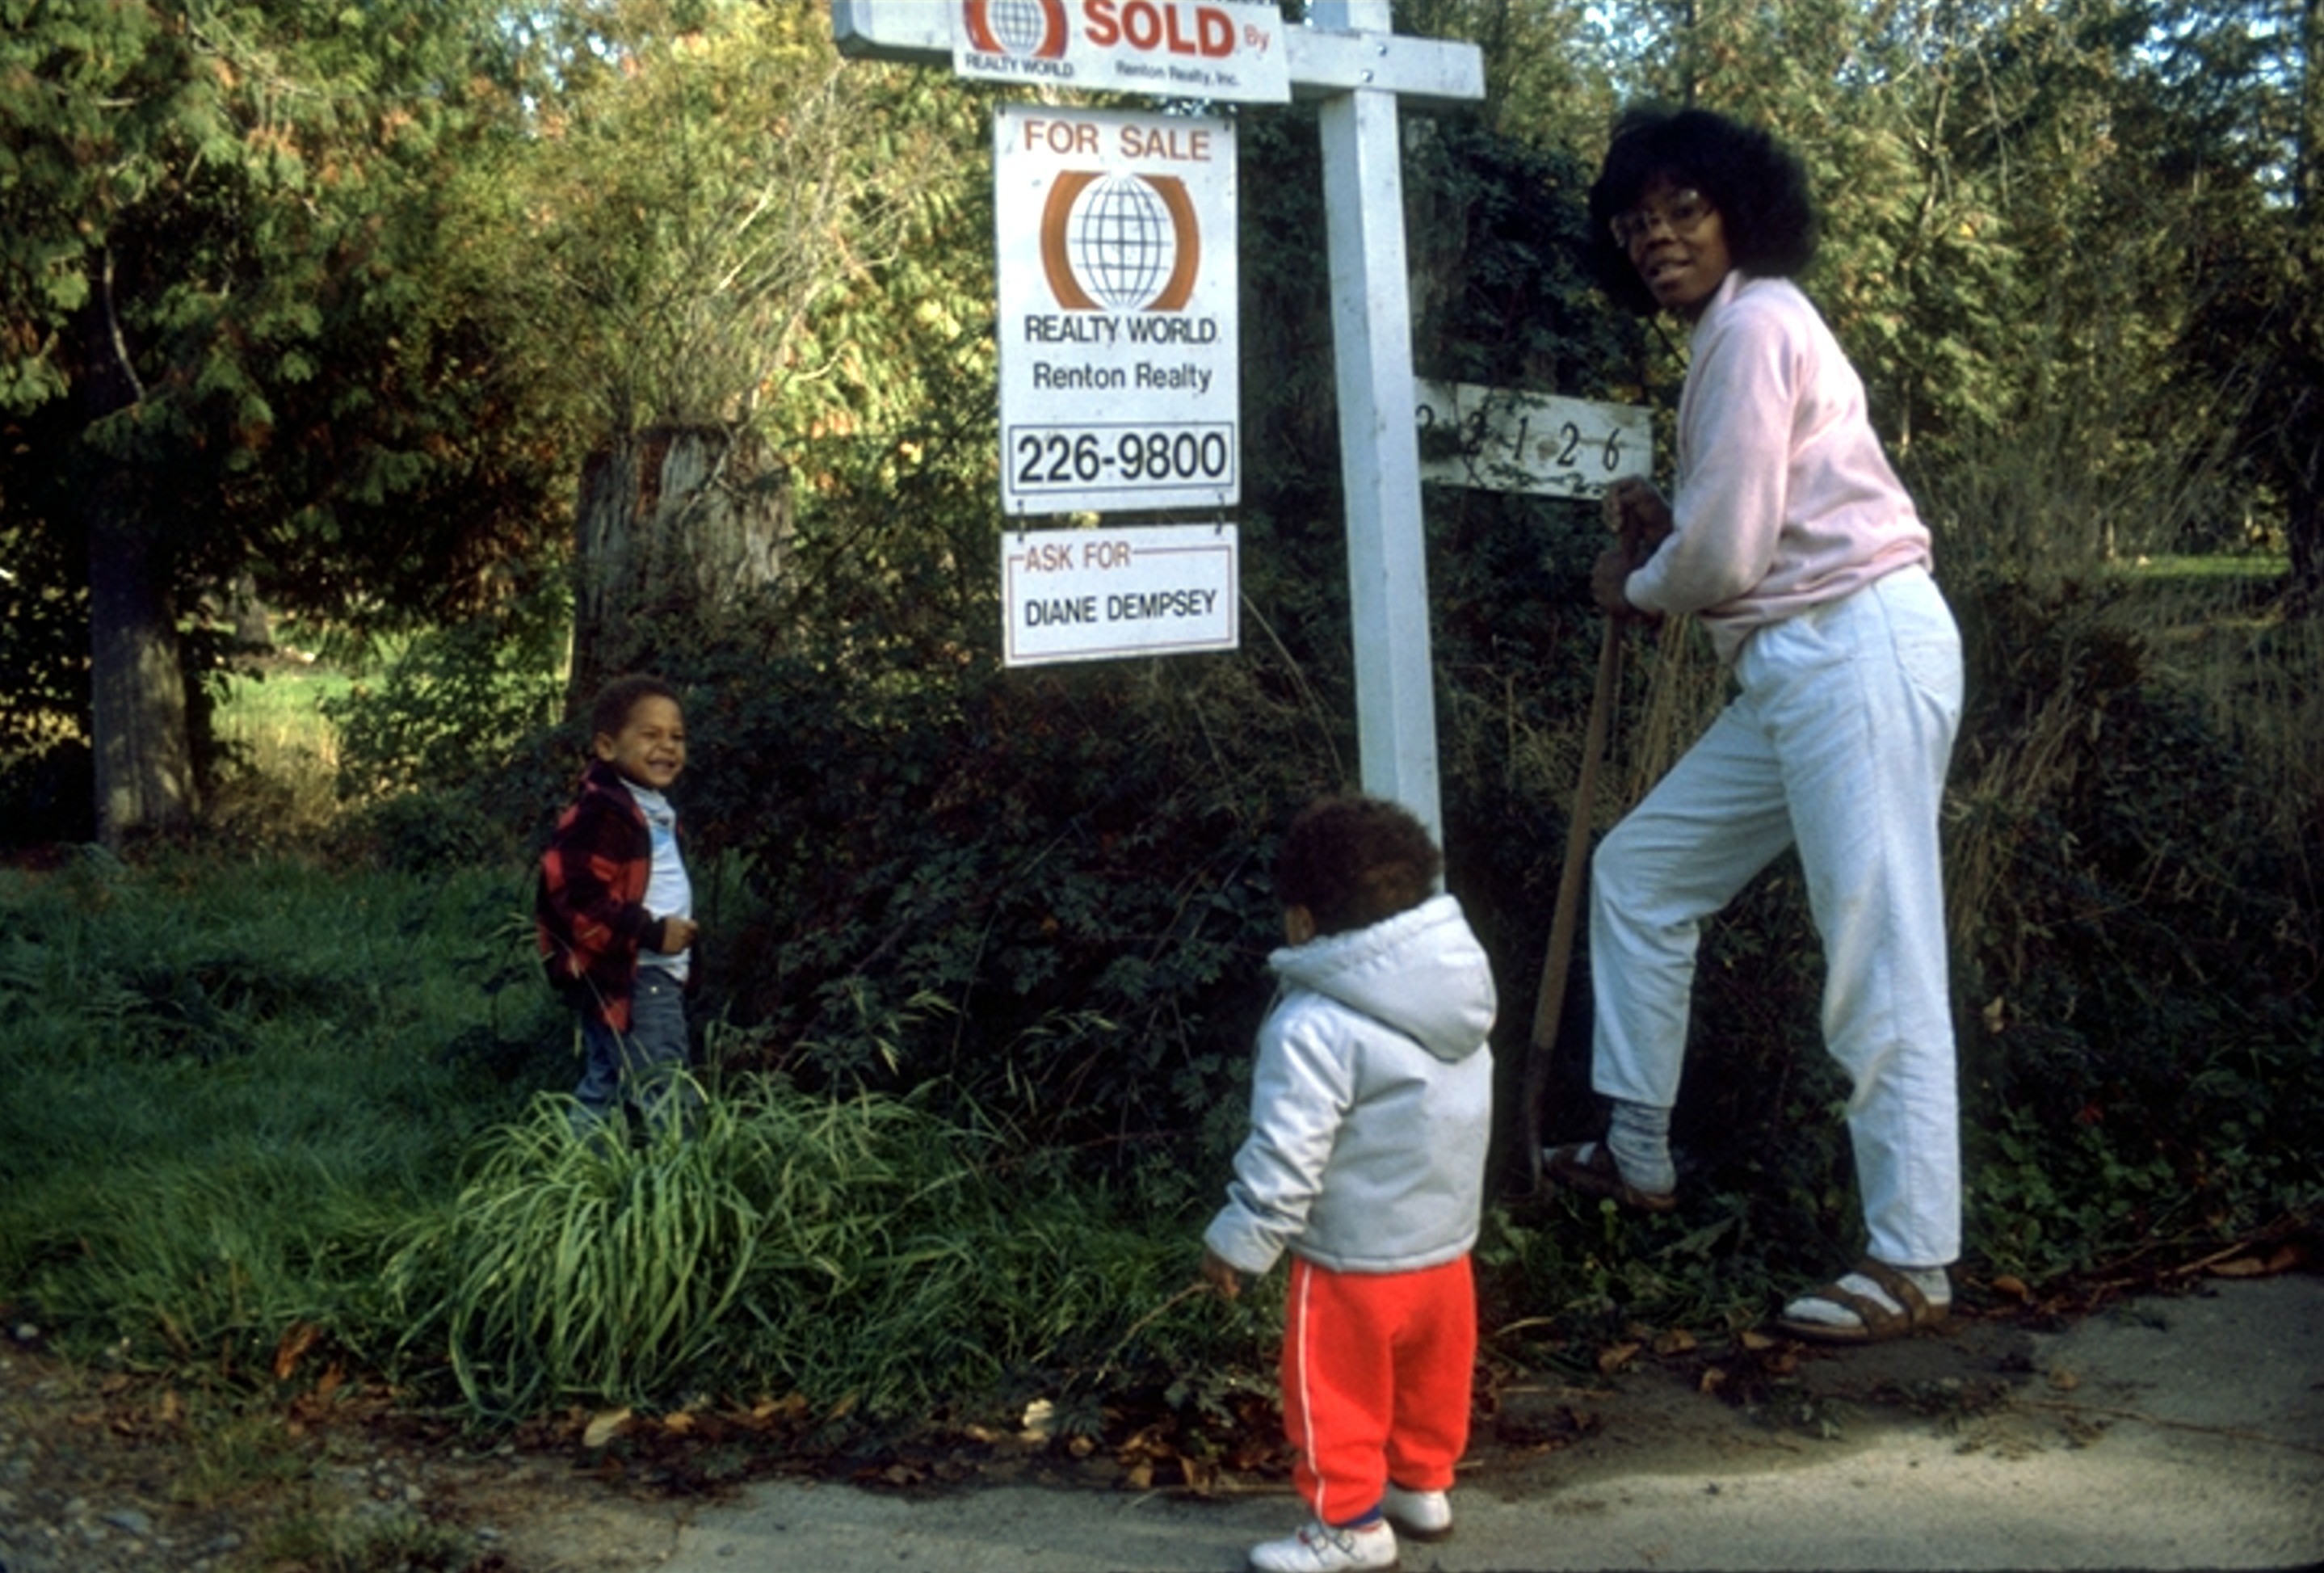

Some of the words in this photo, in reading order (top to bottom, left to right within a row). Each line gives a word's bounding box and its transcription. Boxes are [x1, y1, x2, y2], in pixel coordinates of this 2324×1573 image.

[1082, 0, 1236, 59] SOLD
[1244, 23, 1270, 53] By
[965, 53, 1018, 72] REALTY
[1022, 59, 1074, 78] WORLD
[1116, 60, 1166, 78] Renton
[1023, 120, 1099, 154] FOR
[1120, 124, 1212, 162] SALE
[1024, 314, 1120, 343] REALTY
[1127, 318, 1217, 344] WORLD
[1033, 362, 1125, 389] Renton
[1135, 362, 1212, 393] Realty
[1017, 431, 1226, 483] 226-9800
[1025, 543, 1074, 572] ASK
[1083, 540, 1131, 570] FOR
[1025, 595, 1098, 627] DIANE
[1107, 589, 1217, 621] DEMPSEY
